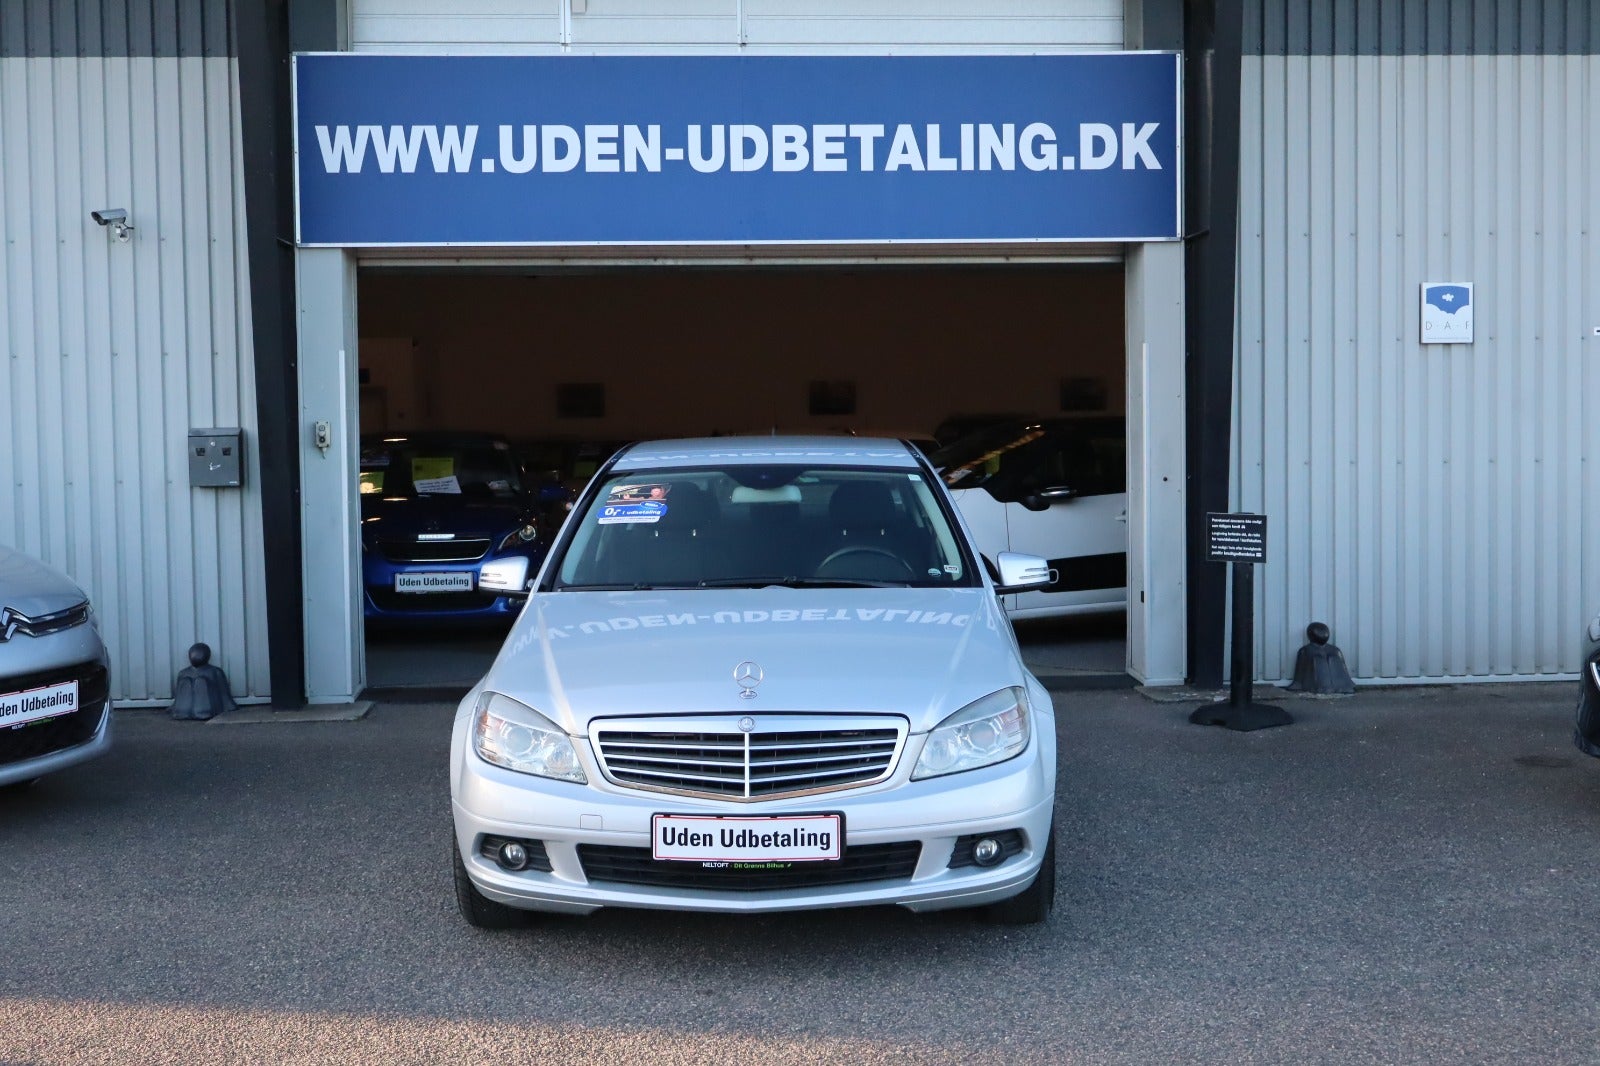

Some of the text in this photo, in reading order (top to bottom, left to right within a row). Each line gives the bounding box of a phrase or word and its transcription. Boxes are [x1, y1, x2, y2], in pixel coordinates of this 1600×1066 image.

[314, 122, 1162, 173] WWW.UDEN-UDBETALING.DK
[399, 576, 469, 587] Uden Udbetaling
[0, 691, 74, 718] den Udbetaling
[662, 826, 831, 851] Uden Udbetaling
